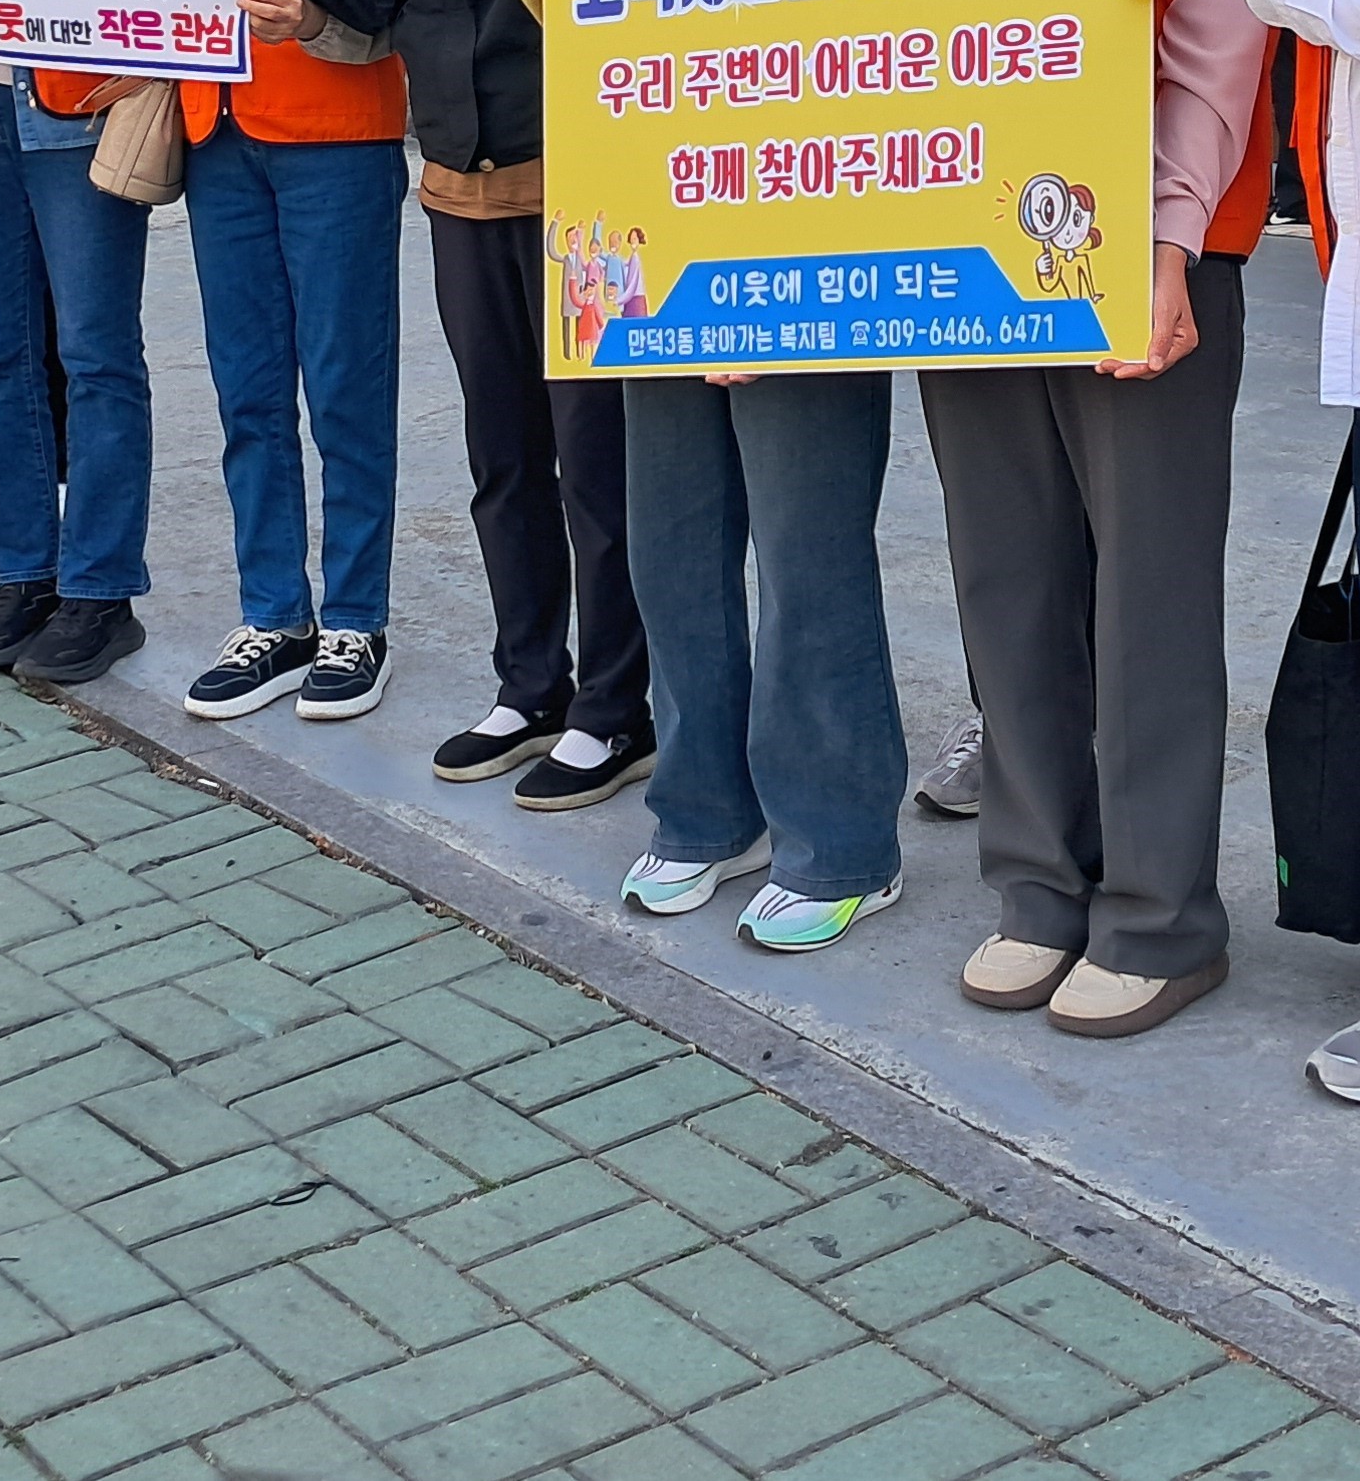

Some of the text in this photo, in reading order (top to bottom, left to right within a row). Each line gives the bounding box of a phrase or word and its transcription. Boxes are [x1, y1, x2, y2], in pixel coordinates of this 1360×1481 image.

[51, 20, 92, 46] 대한
[98, 8, 164, 50] 작은
[170, 11, 234, 55] 관심
[600, 16, 1082, 115] 우리 주변의 어려운 이웃을
[669, 124, 983, 205] 함께 찾아주세요!
[710, 263, 959, 307] 이웃에 힘이 되는
[628, 313, 1054, 357] 만덕3동 찾아가는 복지팀 309-6466, 6471
